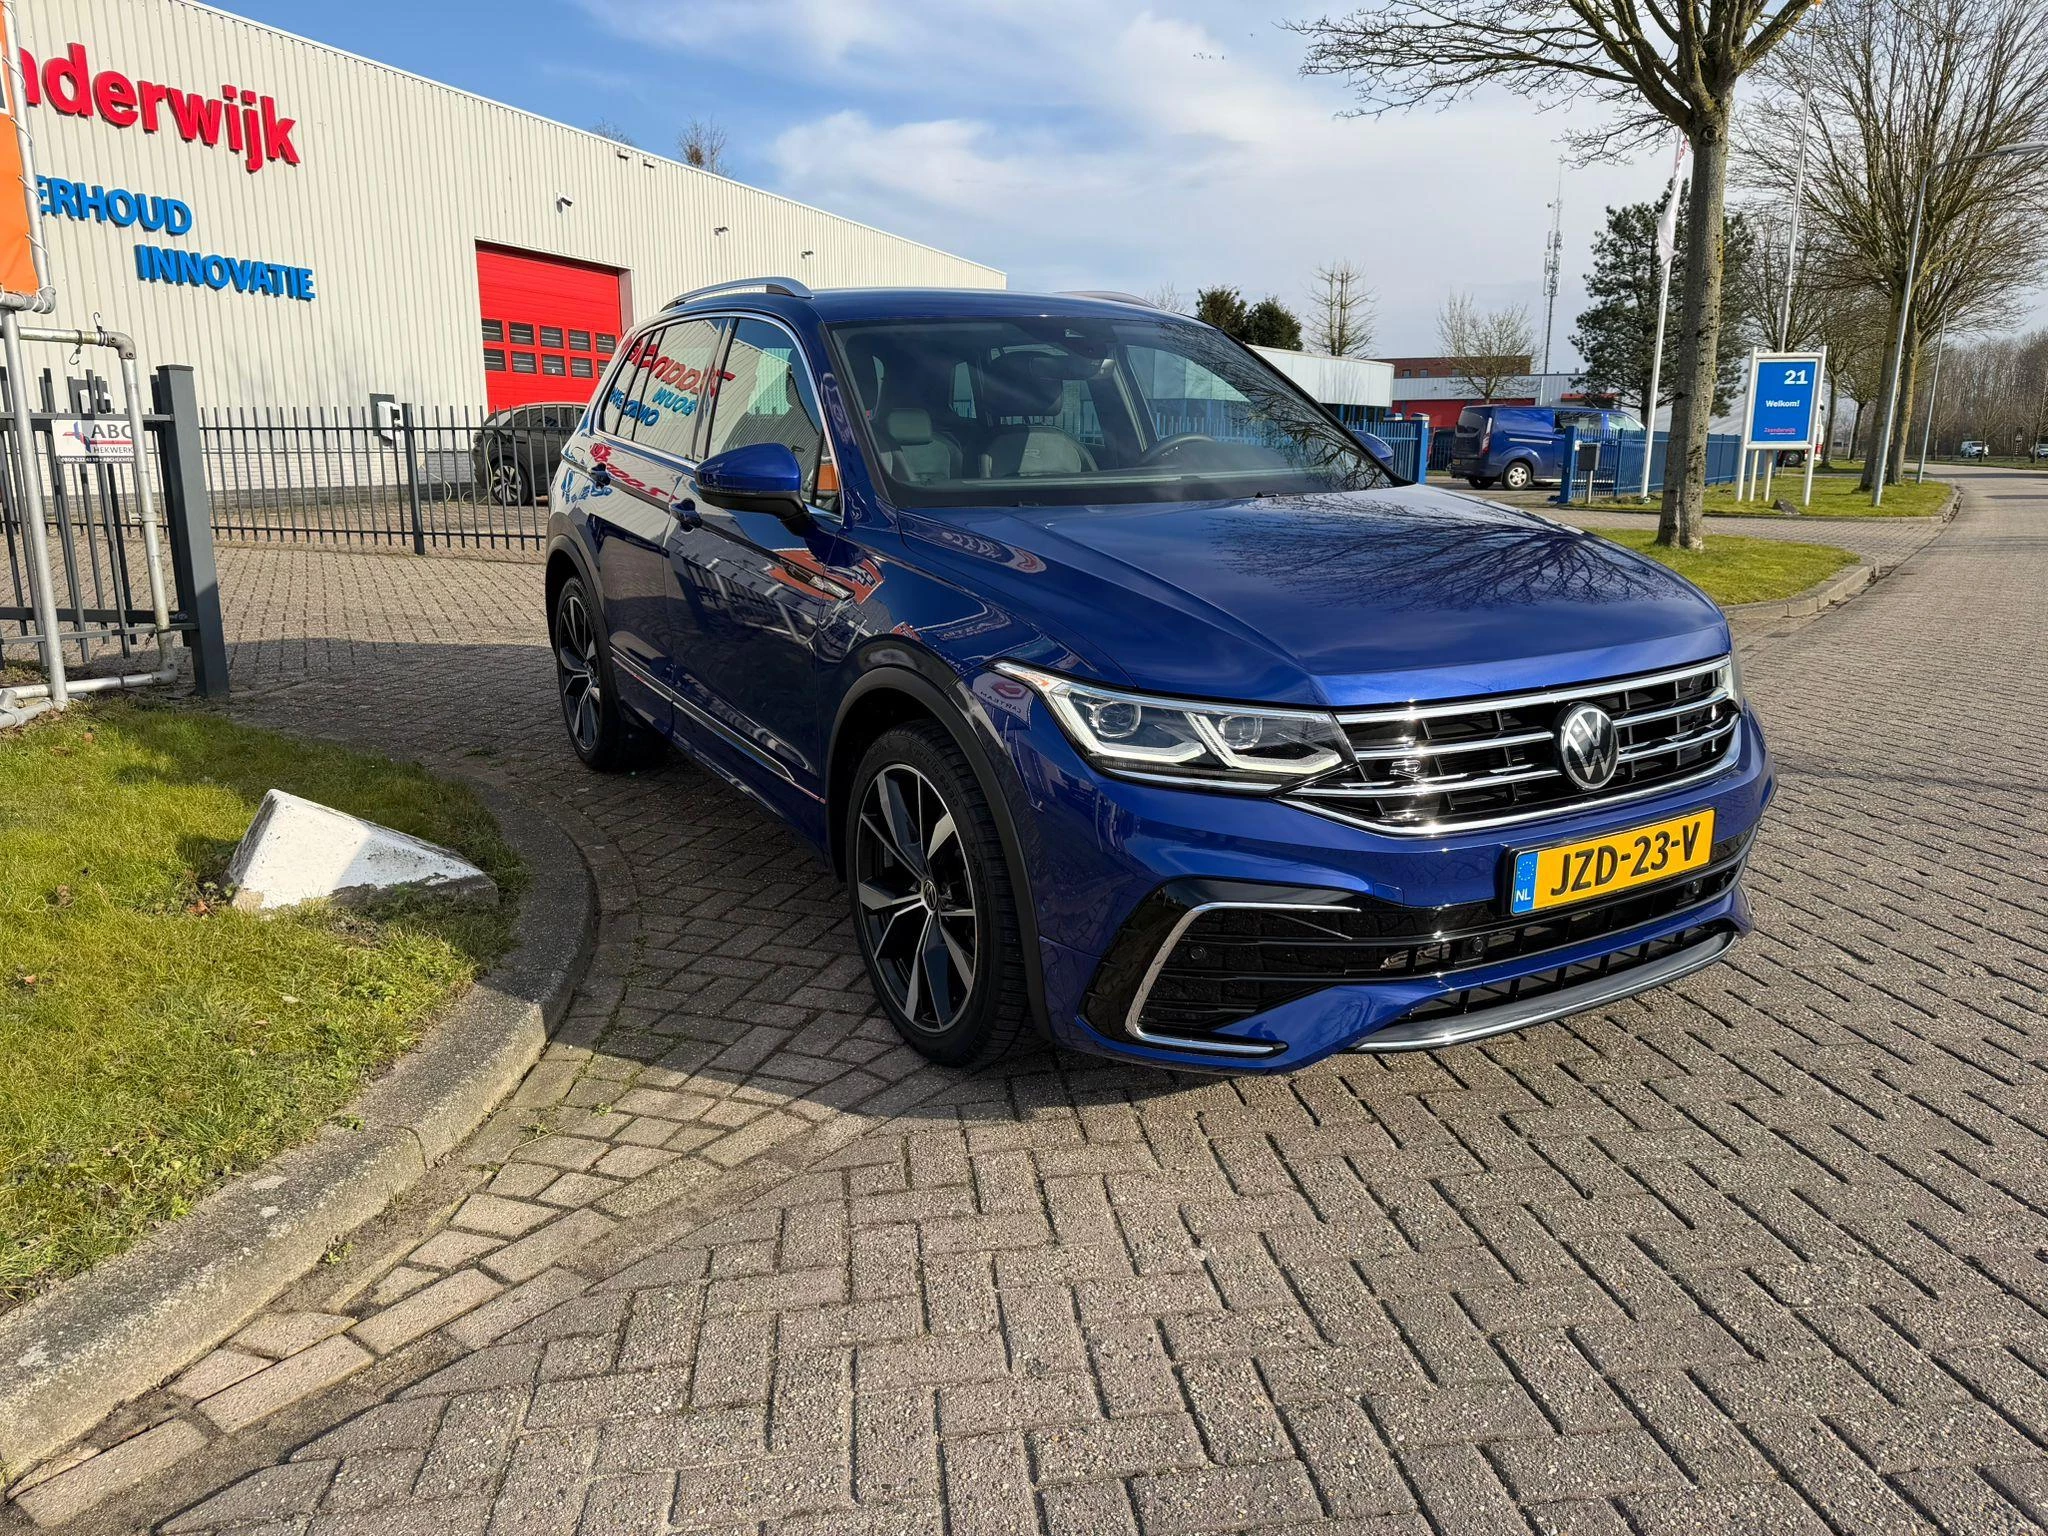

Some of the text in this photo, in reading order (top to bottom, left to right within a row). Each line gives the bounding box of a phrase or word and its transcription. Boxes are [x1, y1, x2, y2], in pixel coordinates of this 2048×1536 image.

[134, 244, 315, 301] INNOVATIE
[1784, 369, 1808, 385] 21
[1765, 399, 1800, 408] Welkom!
[1550, 821, 1701, 897] JZD-23-V
[1515, 888, 1532, 902] NL
